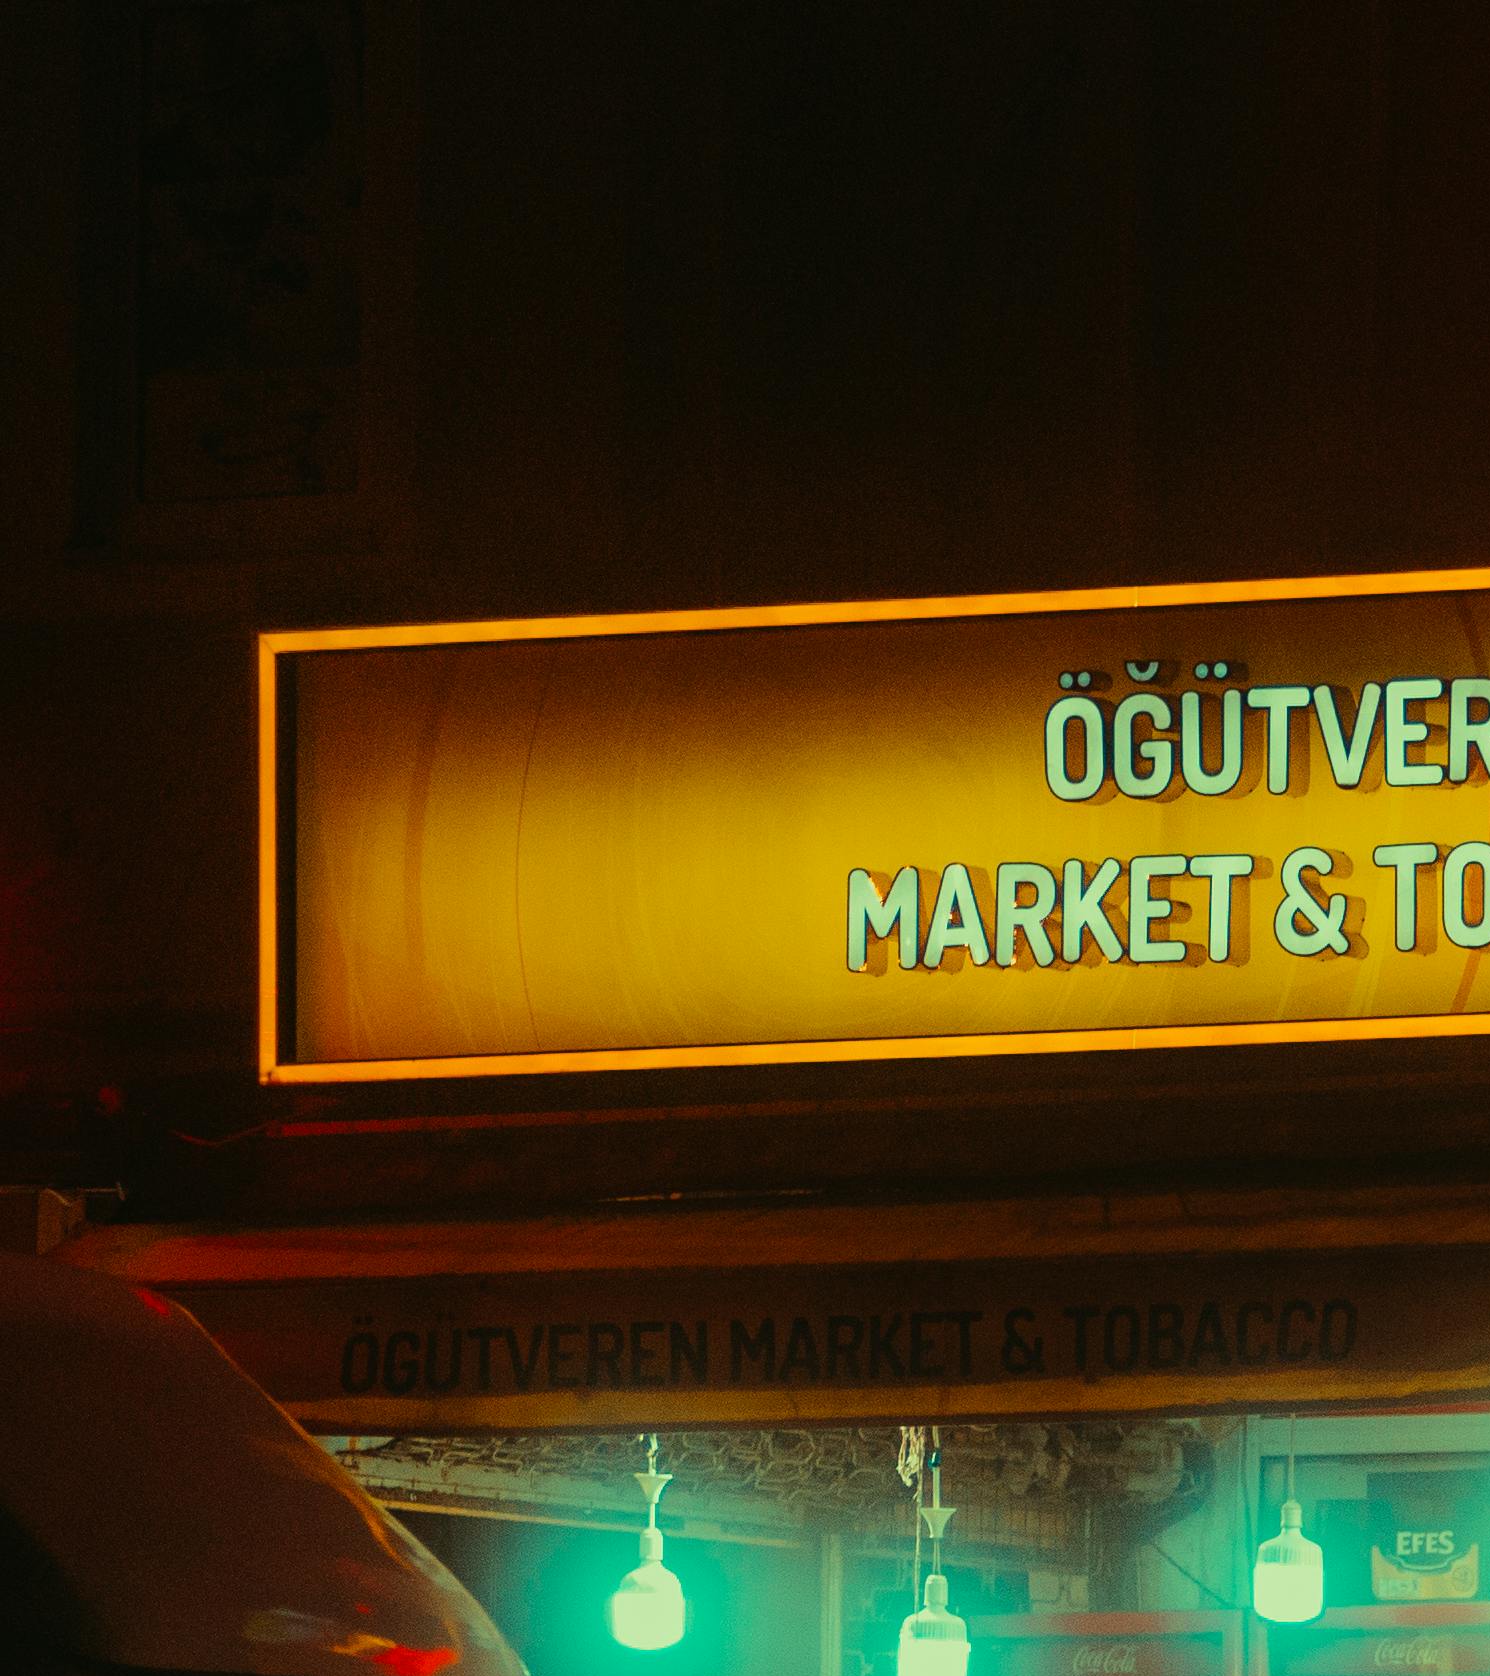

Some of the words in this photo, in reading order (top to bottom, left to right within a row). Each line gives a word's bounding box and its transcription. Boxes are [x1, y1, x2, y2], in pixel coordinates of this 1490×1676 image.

[845, 850, 1254, 974] MARKET
[1272, 844, 1350, 958] &
[728, 1309, 984, 1385] MARKET
[1000, 1306, 1045, 1375] &
[1064, 1297, 1358, 1373] TOBACCO
[1396, 1530, 1454, 1555] EFES
